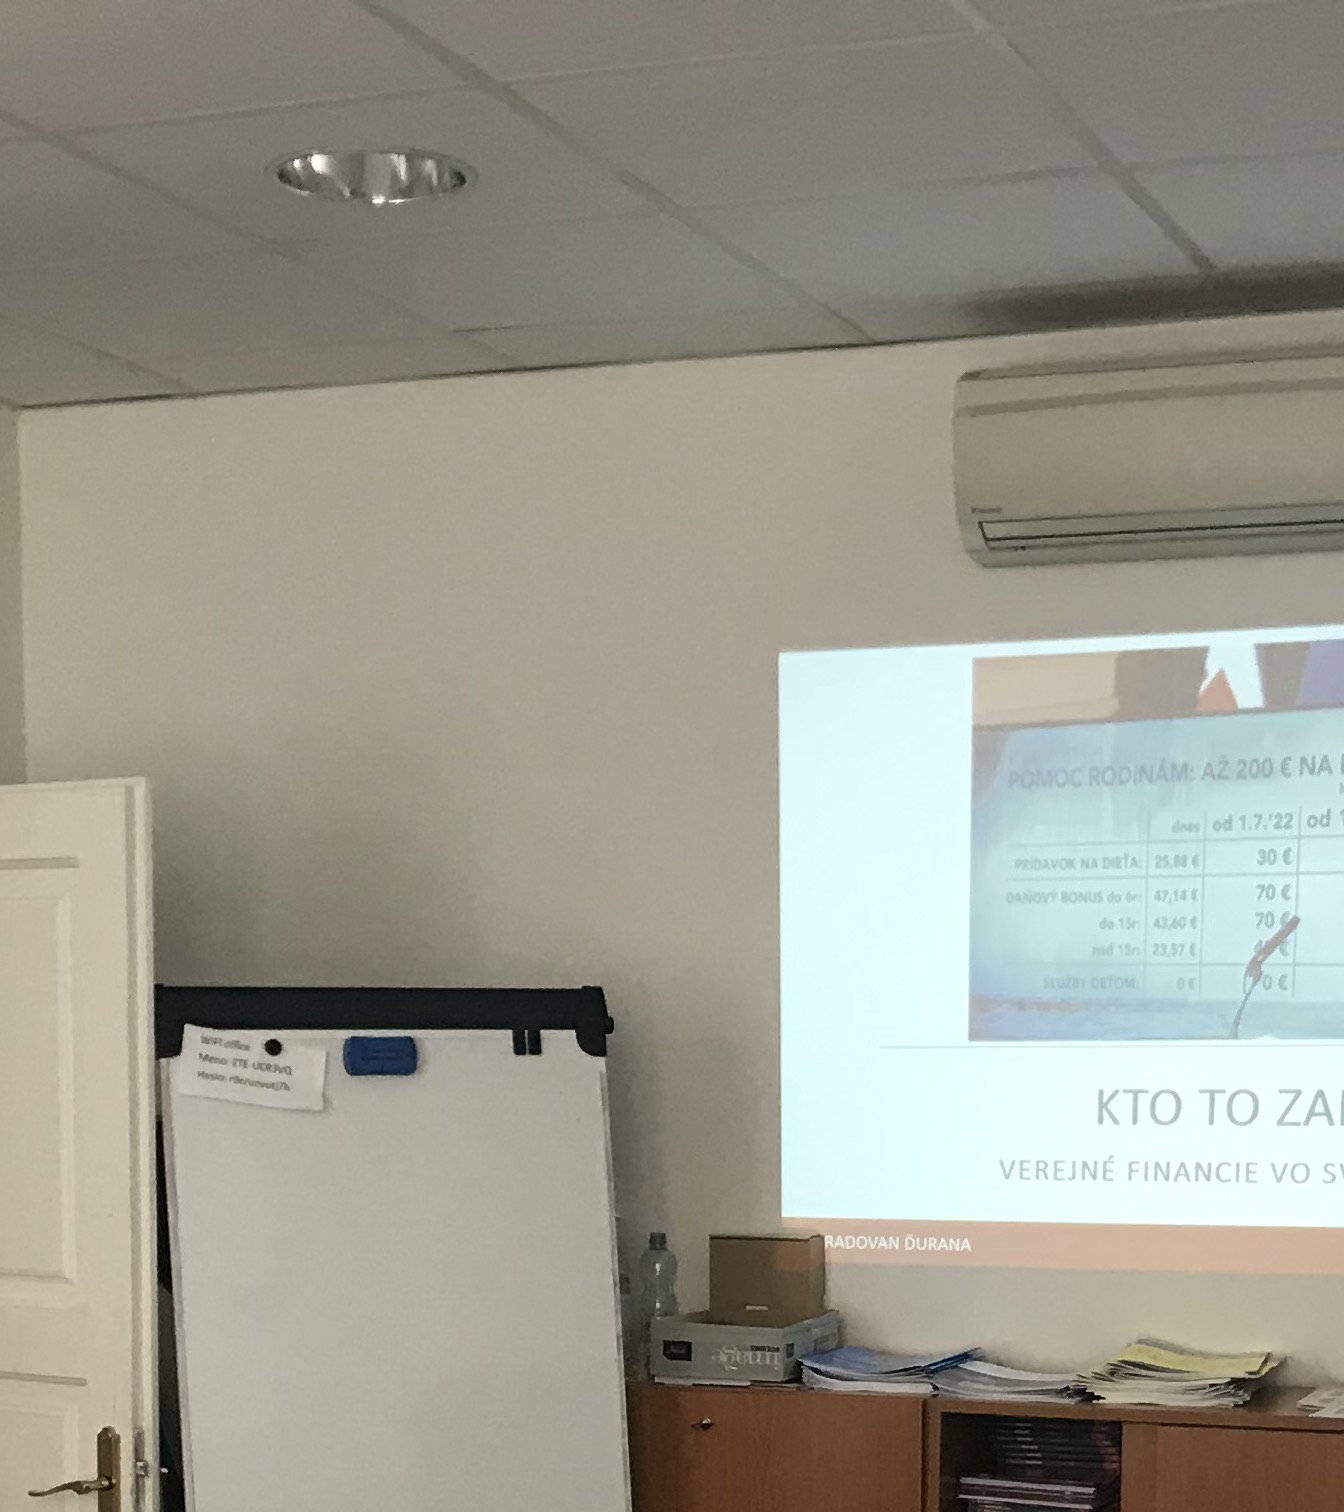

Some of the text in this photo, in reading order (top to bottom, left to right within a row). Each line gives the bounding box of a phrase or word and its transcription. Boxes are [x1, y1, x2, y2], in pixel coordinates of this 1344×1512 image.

[1007, 765, 1081, 791] POMOC
[1088, 759, 1195, 787] RODINÁM:
[1200, 754, 1230, 780] AŽ
[1235, 757, 1274, 780] 200
[1280, 756, 1293, 778] €
[1298, 755, 1334, 777] NA
[1212, 813, 1233, 832] od
[1307, 808, 1331, 828] od
[1080, 857, 1098, 870] NA
[1191, 853, 1200, 868] €
[1256, 848, 1293, 866] 30 €
[1061, 891, 1104, 904] BONUS
[1107, 890, 1122, 904] do
[1153, 888, 1199, 904] 47,14 €
[1255, 883, 1292, 901] 70 €
[1099, 917, 1114, 930] do
[1153, 916, 1198, 931] 43,60 €
[1255, 911, 1275, 929] 70
[1152, 943, 1197, 957] 23,57 €
[1176, 977, 1195, 991] 0 €
[1278, 974, 1288, 990] €
[1097, 1088, 1182, 1126] KTO
[1199, 1088, 1260, 1127] TO
[999, 1155, 1115, 1182] VEREJNÉ
[1127, 1161, 1259, 1184] FINANCIE
[1271, 1162, 1311, 1184] VO
[824, 1233, 972, 1252] RADOVAN ĎURANA
